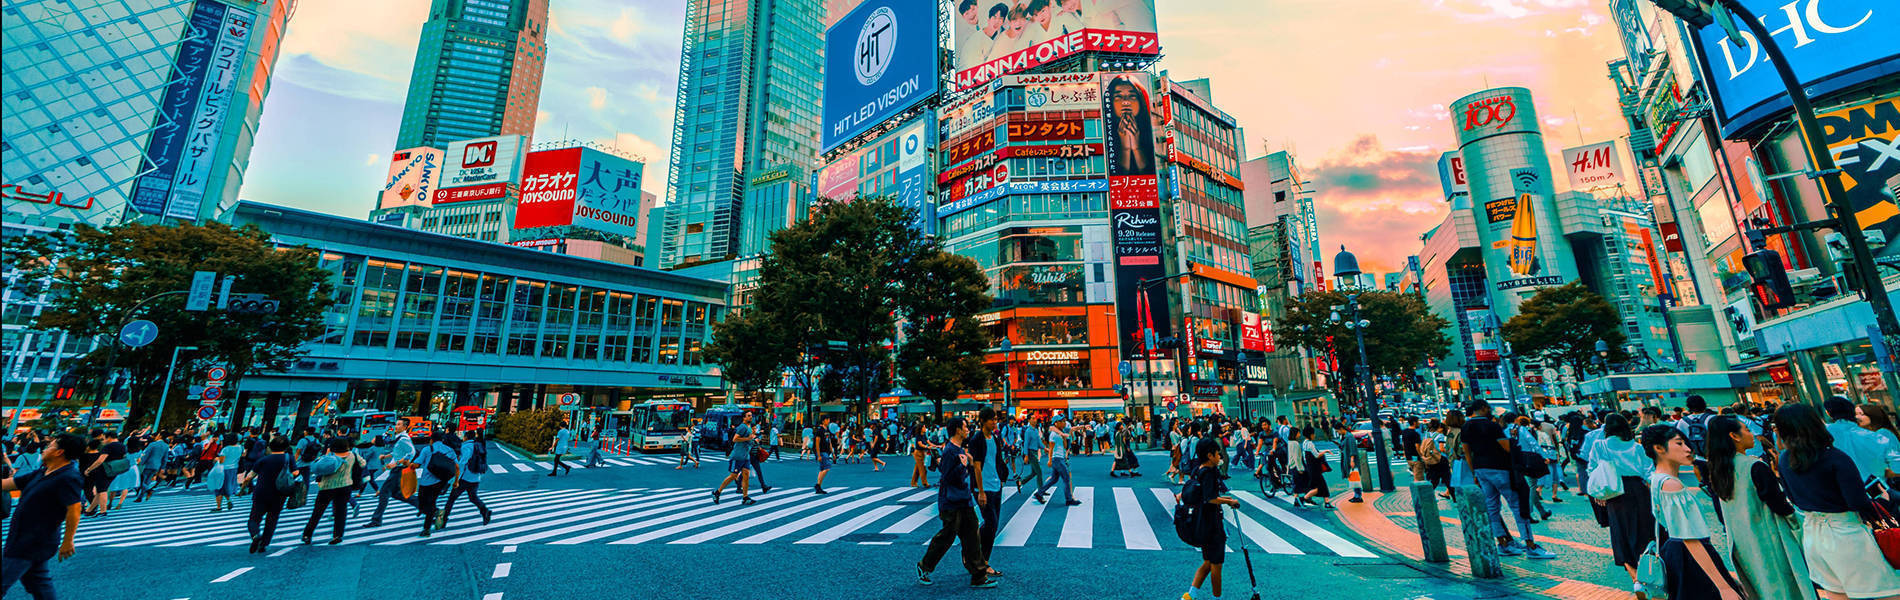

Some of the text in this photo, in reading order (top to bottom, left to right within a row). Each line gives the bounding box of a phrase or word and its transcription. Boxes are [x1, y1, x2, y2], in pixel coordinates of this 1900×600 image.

[1087, 32, 1156, 50] ワナワン
[1717, 0, 1873, 81] DHC
[1051, 88, 1097, 103] しゃぶ葉
[834, 115, 852, 137] HIT
[853, 101, 876, 125] LED
[877, 74, 920, 112] VISION
[180, 46, 236, 185] ワコールビッグバザール
[1463, 101, 1516, 131] 109
[941, 124, 949, 134] 9F
[1009, 122, 1082, 137] コンタクト
[465, 144, 493, 166] DC
[1060, 145, 1095, 157] ガスト
[1571, 146, 1610, 173] H&M
[385, 155, 423, 190] SANKYO
[417, 152, 437, 201] SANKYO
[524, 171, 576, 191] カラオケ
[581, 160, 641, 193] 大声
[964, 173, 993, 197] ガスト
[1111, 176, 1156, 189] ユリゴコロ
[520, 189, 575, 204] JOYSOUND
[940, 189, 951, 201] 7F
[1116, 199, 1138, 208] 9.23
[575, 204, 636, 228] JOYSOUND
[1114, 212, 1157, 228] Rihwa
[1117, 229, 1135, 237] 9.20
[1514, 248, 1532, 261] BIG
[1027, 350, 1079, 360] L'OCCITANE
[1246, 365, 1268, 380] LUSH
